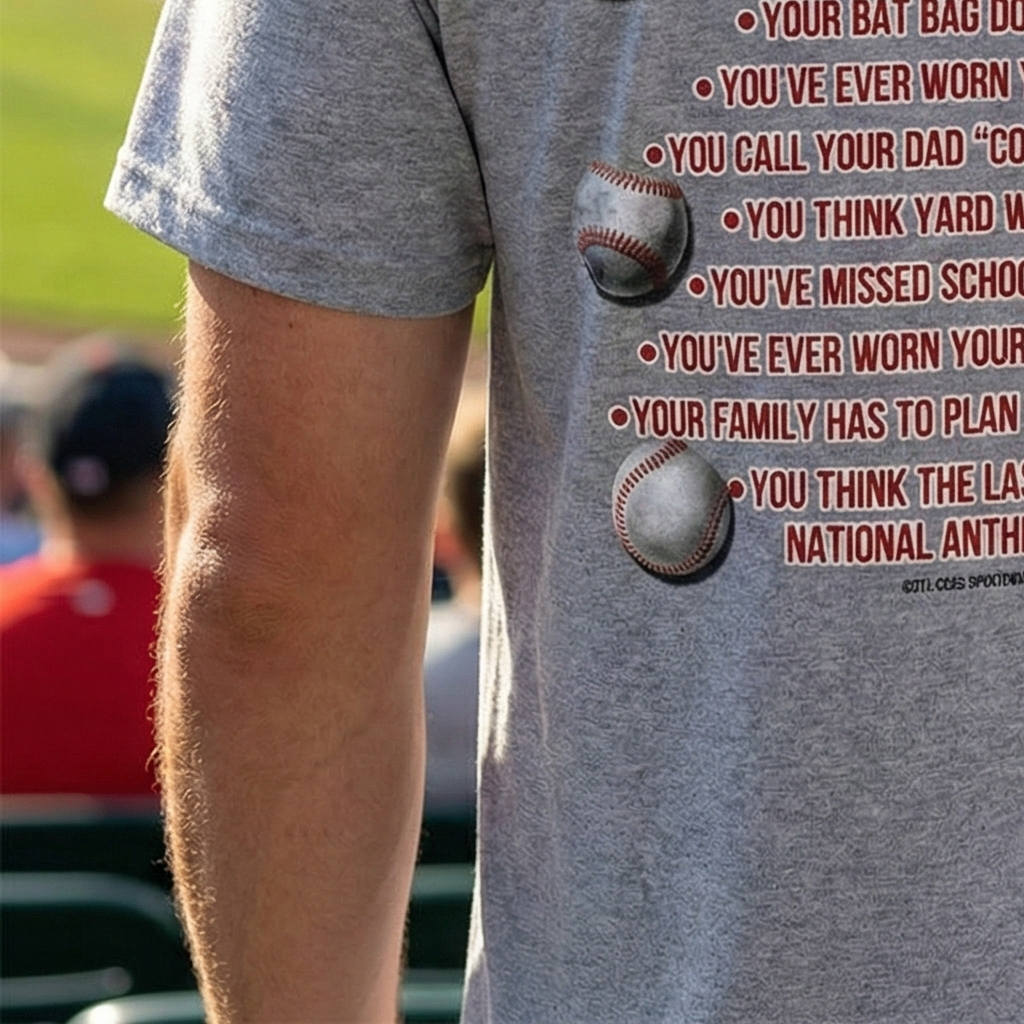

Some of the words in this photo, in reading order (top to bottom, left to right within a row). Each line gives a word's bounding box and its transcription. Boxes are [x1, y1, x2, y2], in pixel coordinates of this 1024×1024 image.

[834, 63, 912, 104] EVER
[919, 60, 1010, 100] WORN
[669, 135, 726, 174] YOU
[734, 135, 806, 173] CALL
[816, 131, 896, 172] YOUR
[904, 128, 965, 168] DAD
[746, 200, 804, 240] YOU
[815, 198, 903, 237] THINK
[915, 194, 995, 234] YARD
[711, 268, 813, 306] YOU'VE
[820, 263, 931, 306] MISSED
[664, 335, 760, 373] YOU'VE
[767, 334, 842, 374] EVER
[852, 331, 941, 372] WORN
[635, 399, 705, 437] YOUR
[712, 401, 814, 440] FAMILY
[825, 400, 886, 440] HAS
[897, 398, 934, 437] TO
[943, 395, 1019, 435] PLAN
[752, 471, 806, 509] YOU
[818, 469, 906, 508] THINK
[918, 465, 973, 505] THE
[786, 523, 931, 564] NATIONAL
